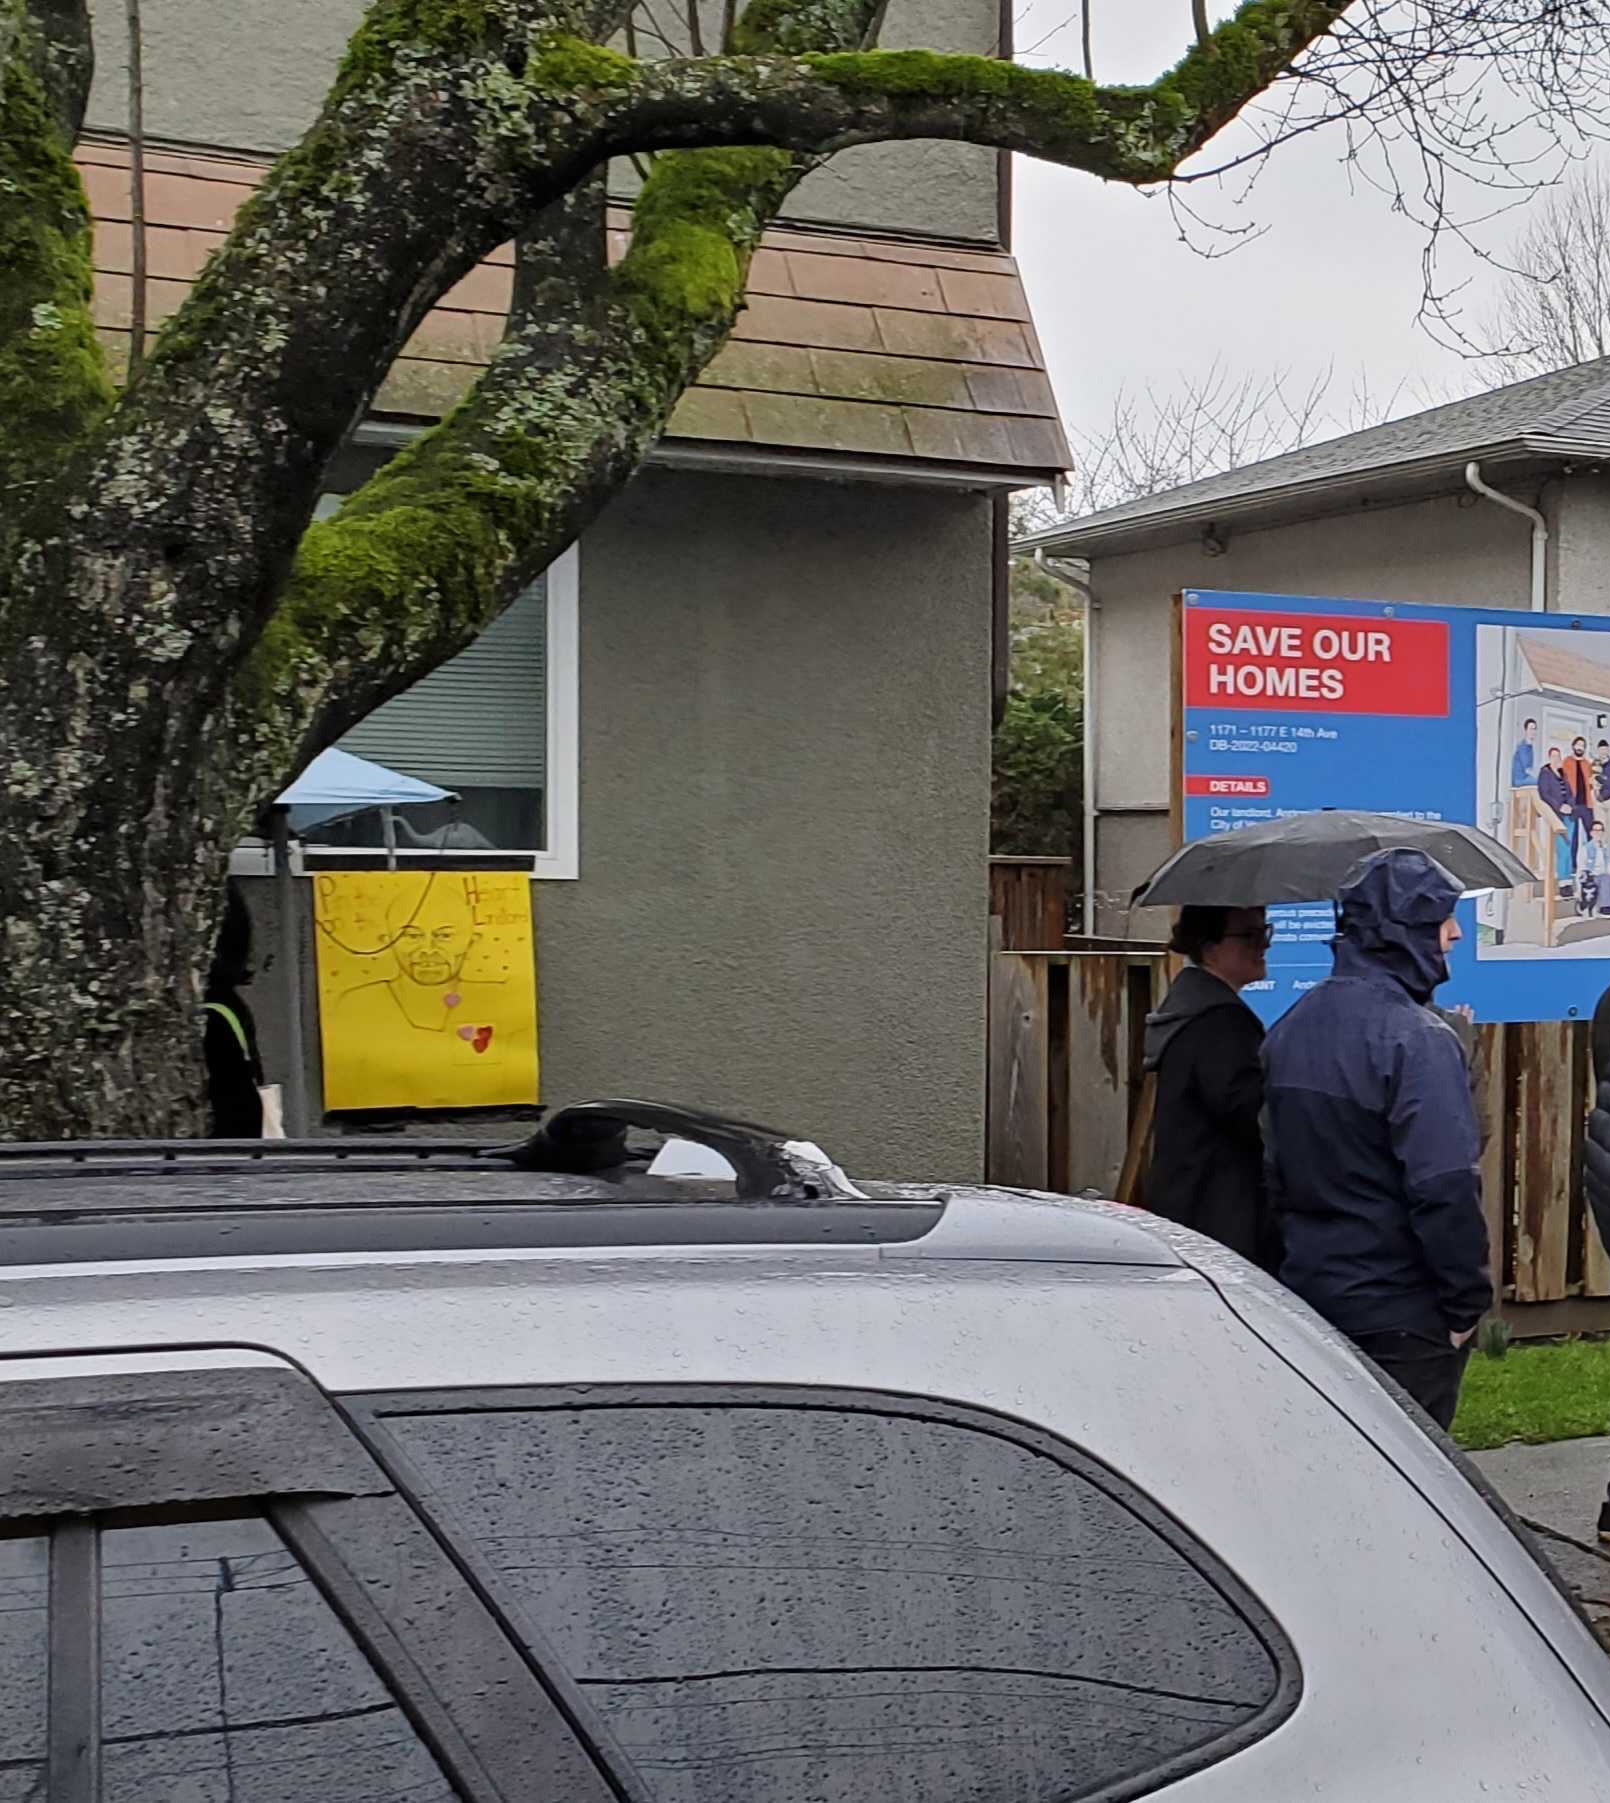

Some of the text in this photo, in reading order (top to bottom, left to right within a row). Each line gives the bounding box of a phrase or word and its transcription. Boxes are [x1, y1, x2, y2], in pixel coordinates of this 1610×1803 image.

[1208, 623, 1392, 662] SAVE OUR
[1209, 664, 1345, 700] HOMES
[1209, 724, 1237, 736] 1171
[1250, 725, 1277, 737] 1177
[1279, 726, 1288, 738] E
[1291, 727, 1315, 739] 14th
[1316, 728, 1339, 739] Ave
[1209, 781, 1267, 793] DETAILS
[1210, 806, 1230, 817] Our
